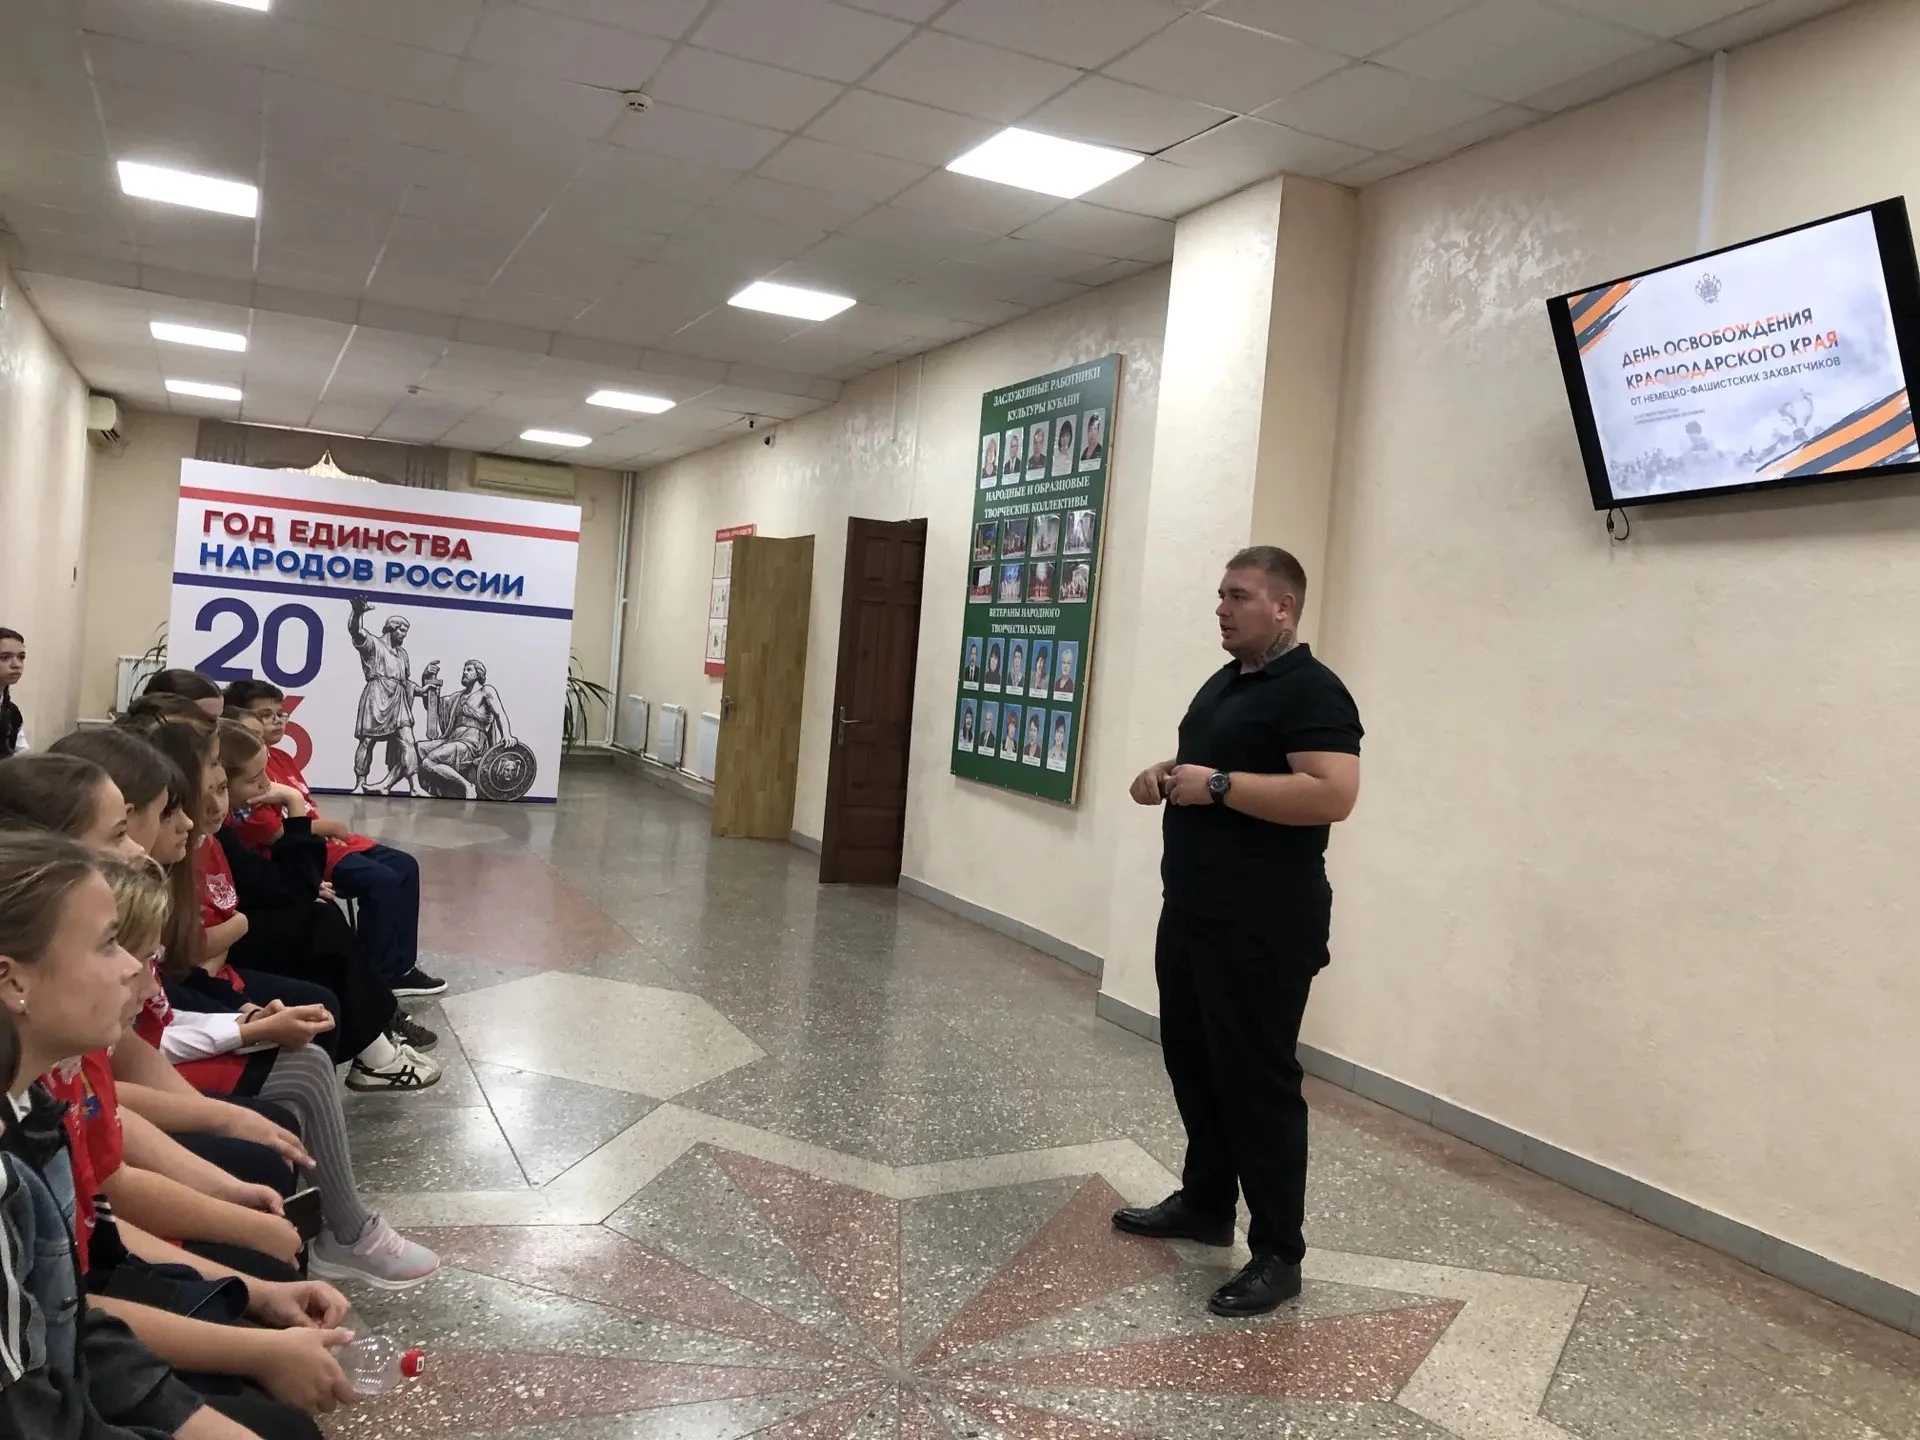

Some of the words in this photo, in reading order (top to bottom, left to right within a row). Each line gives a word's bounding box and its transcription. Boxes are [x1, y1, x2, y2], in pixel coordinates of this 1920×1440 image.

[1622, 345, 1660, 369] ДЕНЬ
[1664, 307, 1814, 356] ОСВОБОЖДЕНИЯ
[1626, 344, 1786, 390] КРАСНОДАРСКОГО
[1790, 330, 1839, 355] КРАЯ
[993, 381, 1050, 407] ЗАСЛУЖЕННЫЕ
[1050, 366, 1101, 391] РАБОТНИКИ
[1630, 395, 1642, 406] ОТ
[1644, 373, 1761, 404] НЕМЕЦКО-ФАШИСТСКИХ
[1762, 356, 1842, 381] ЗАХВАТЧИКОВ
[1007, 402, 1046, 422] КУЛЬТУРЫ
[1047, 393, 1080, 412] КУБАНИ
[984, 504, 1030, 518] ТВОРЧЕСКИЕ
[1031, 495, 1088, 513] КОЛЛЕКТИВЫ
[985, 486, 1026, 502] НАРОДНЫЕ
[1027, 485, 1034, 496] И
[1034, 476, 1090, 494] ОБРАЗЦОВЫЕ
[203, 510, 275, 544] ГОД
[289, 520, 473, 562] ЕДИНСТВА
[200, 542, 374, 582] НАРОДОВ
[385, 561, 525, 597] РОССИИ
[989, 607, 1020, 618] ВЕТЕРАНЫ
[1021, 607, 1060, 619] НАРОДНОГО
[991, 624, 1028, 634] ТВОРЧЕСТВА
[1029, 624, 1056, 635] КУБАНИ
[195, 597, 324, 688] 20
